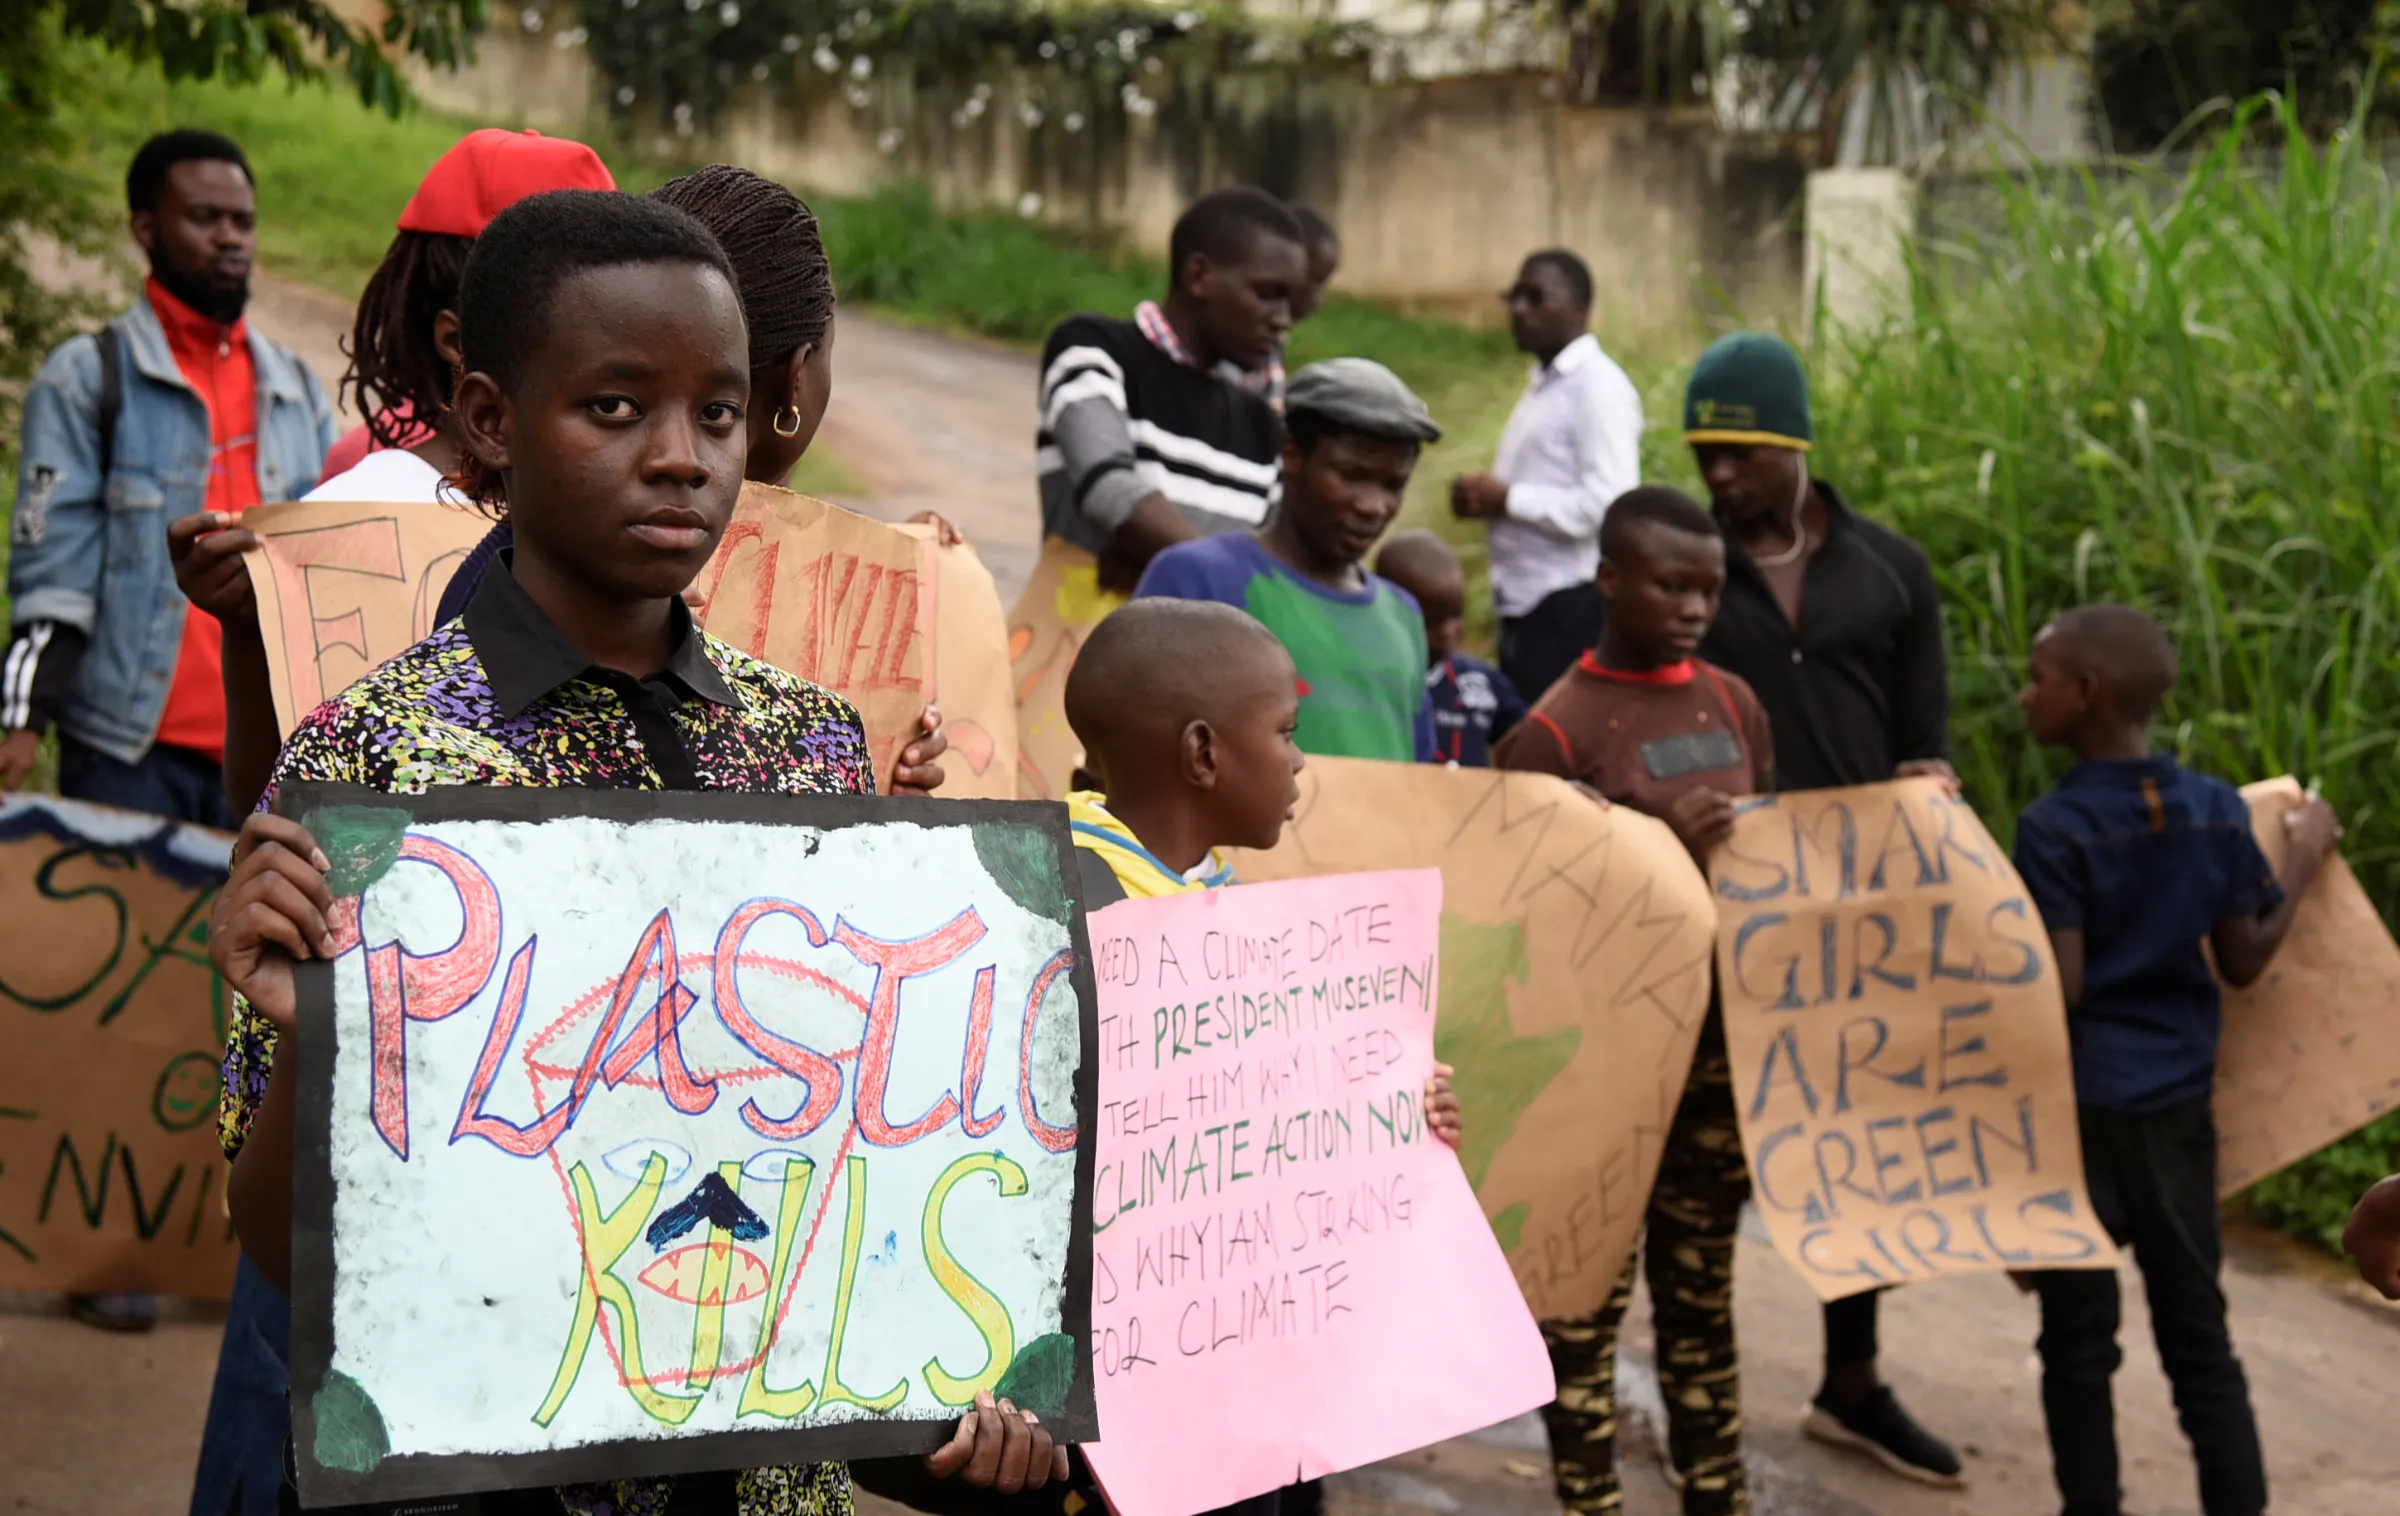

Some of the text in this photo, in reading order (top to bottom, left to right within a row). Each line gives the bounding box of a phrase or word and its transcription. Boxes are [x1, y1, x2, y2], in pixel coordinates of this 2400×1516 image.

[333, 832, 1079, 1162] PLASTIC
[1157, 933, 1188, 989] A
[1203, 928, 1296, 981] CLIMATE
[1309, 903, 1393, 963] DATE
[1732, 898, 2042, 1012] GIRLS
[1153, 985, 1303, 1070] PRESIDENT
[1311, 953, 1434, 1032] MUSEVENI
[1749, 1001, 2008, 1121] ARE
[1104, 1090, 1179, 1136] TELL
[1187, 1062, 1245, 1118] HIM
[1331, 1030, 1404, 1095] NEED
[1093, 1120, 1254, 1235] CLIMATE
[1262, 1108, 1352, 1177] ACTION
[1756, 1093, 2039, 1226] GREEN
[530, 1142, 1029, 1429] KILLS
[1799, 1189, 2098, 1282] GIRLS
[1178, 1260, 1352, 1357] CLIMATE
